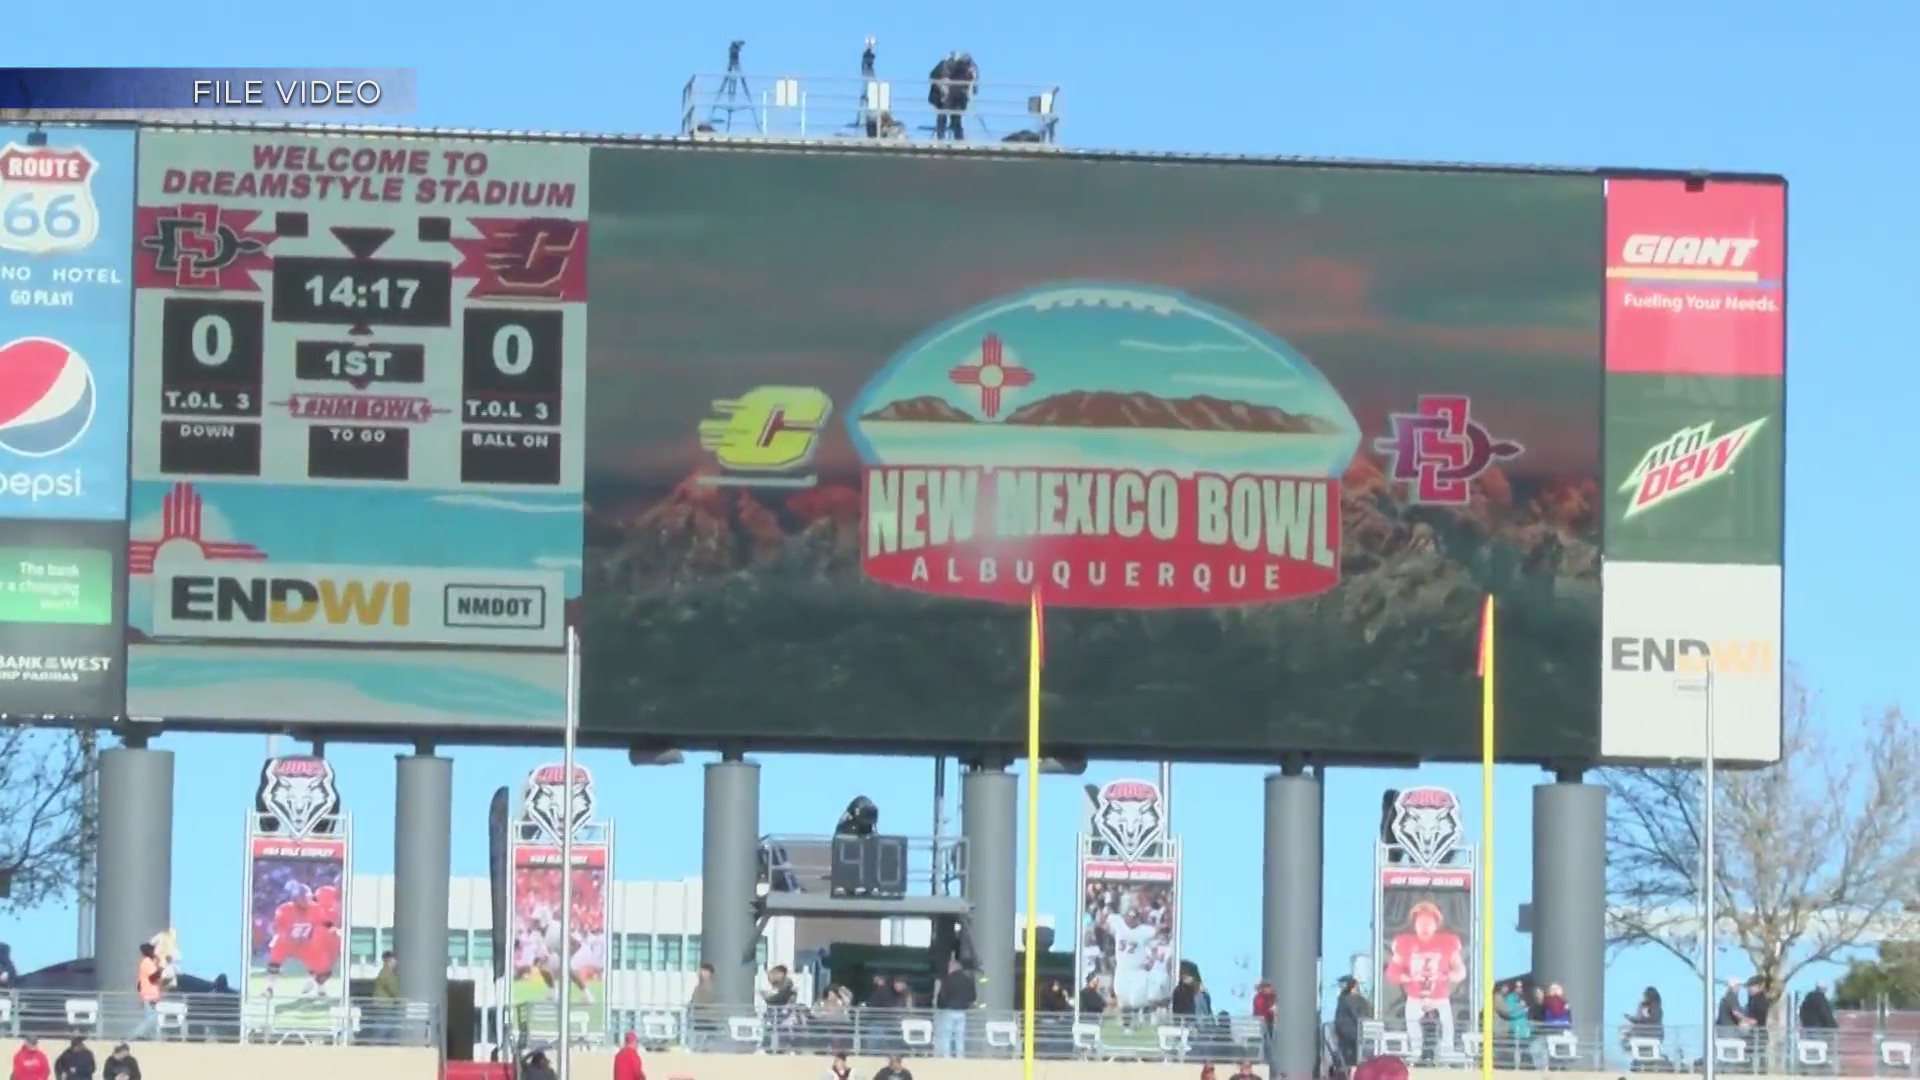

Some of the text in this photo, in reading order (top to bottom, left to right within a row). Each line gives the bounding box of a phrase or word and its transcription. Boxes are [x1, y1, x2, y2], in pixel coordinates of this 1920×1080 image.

[8, 157, 81, 178] ROUTE
[252, 144, 489, 176] WELCOME TO
[161, 168, 576, 209] DREAMSTYLE STADIUM
[4, 192, 81, 239] 66
[1621, 233, 1760, 267] GIANT
[52, 267, 122, 284] HOTEL
[10, 289, 31, 306] GO
[304, 275, 420, 311] 14:17
[1623, 292, 1683, 313] Fueling
[1686, 295, 1722, 310] Your
[191, 313, 233, 367] 0
[492, 324, 534, 376] 0
[324, 349, 393, 377] 1ST
[236, 392, 251, 409] 3
[535, 403, 549, 420] 3
[179, 424, 236, 439] DOWN
[329, 428, 386, 443] TO GO
[472, 433, 549, 448] BALL ON
[867, 468, 1335, 569] NEW MEXICO BOWL
[910, 556, 1281, 591] ALBUQUERQUE
[170, 574, 411, 626] ENDWI
[456, 596, 533, 617] NMDOT
[60, 655, 112, 672] WEST
[1610, 636, 1773, 675] ENDWI
